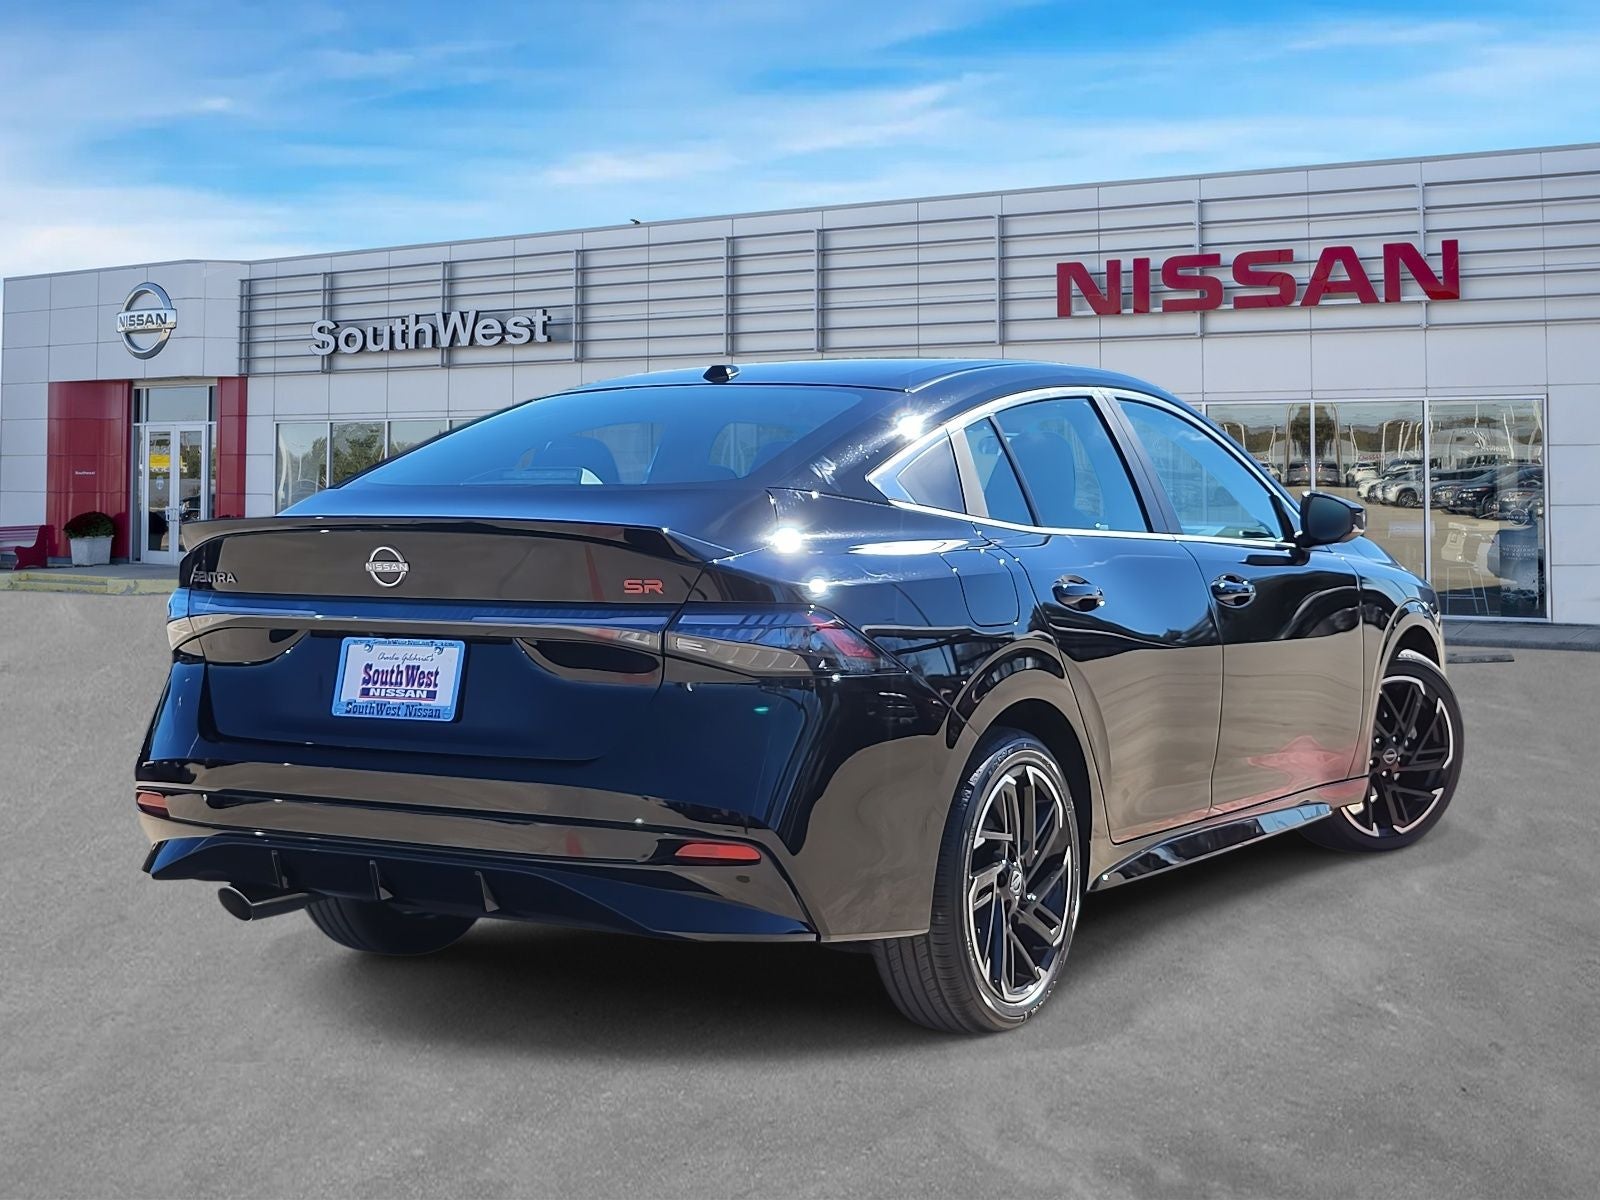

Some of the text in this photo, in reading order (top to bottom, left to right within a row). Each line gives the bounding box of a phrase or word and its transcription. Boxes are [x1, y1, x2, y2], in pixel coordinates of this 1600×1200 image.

[1056, 239, 1460, 318] NISSAN
[119, 312, 167, 328] NISSAN
[309, 308, 551, 356] SouthWest
[365, 561, 409, 573] NISSAN
[623, 579, 664, 595] SR
[361, 663, 440, 689] SouthWest
[369, 688, 427, 699] NISSAN
[344, 701, 441, 719] SouthWest Nissan
